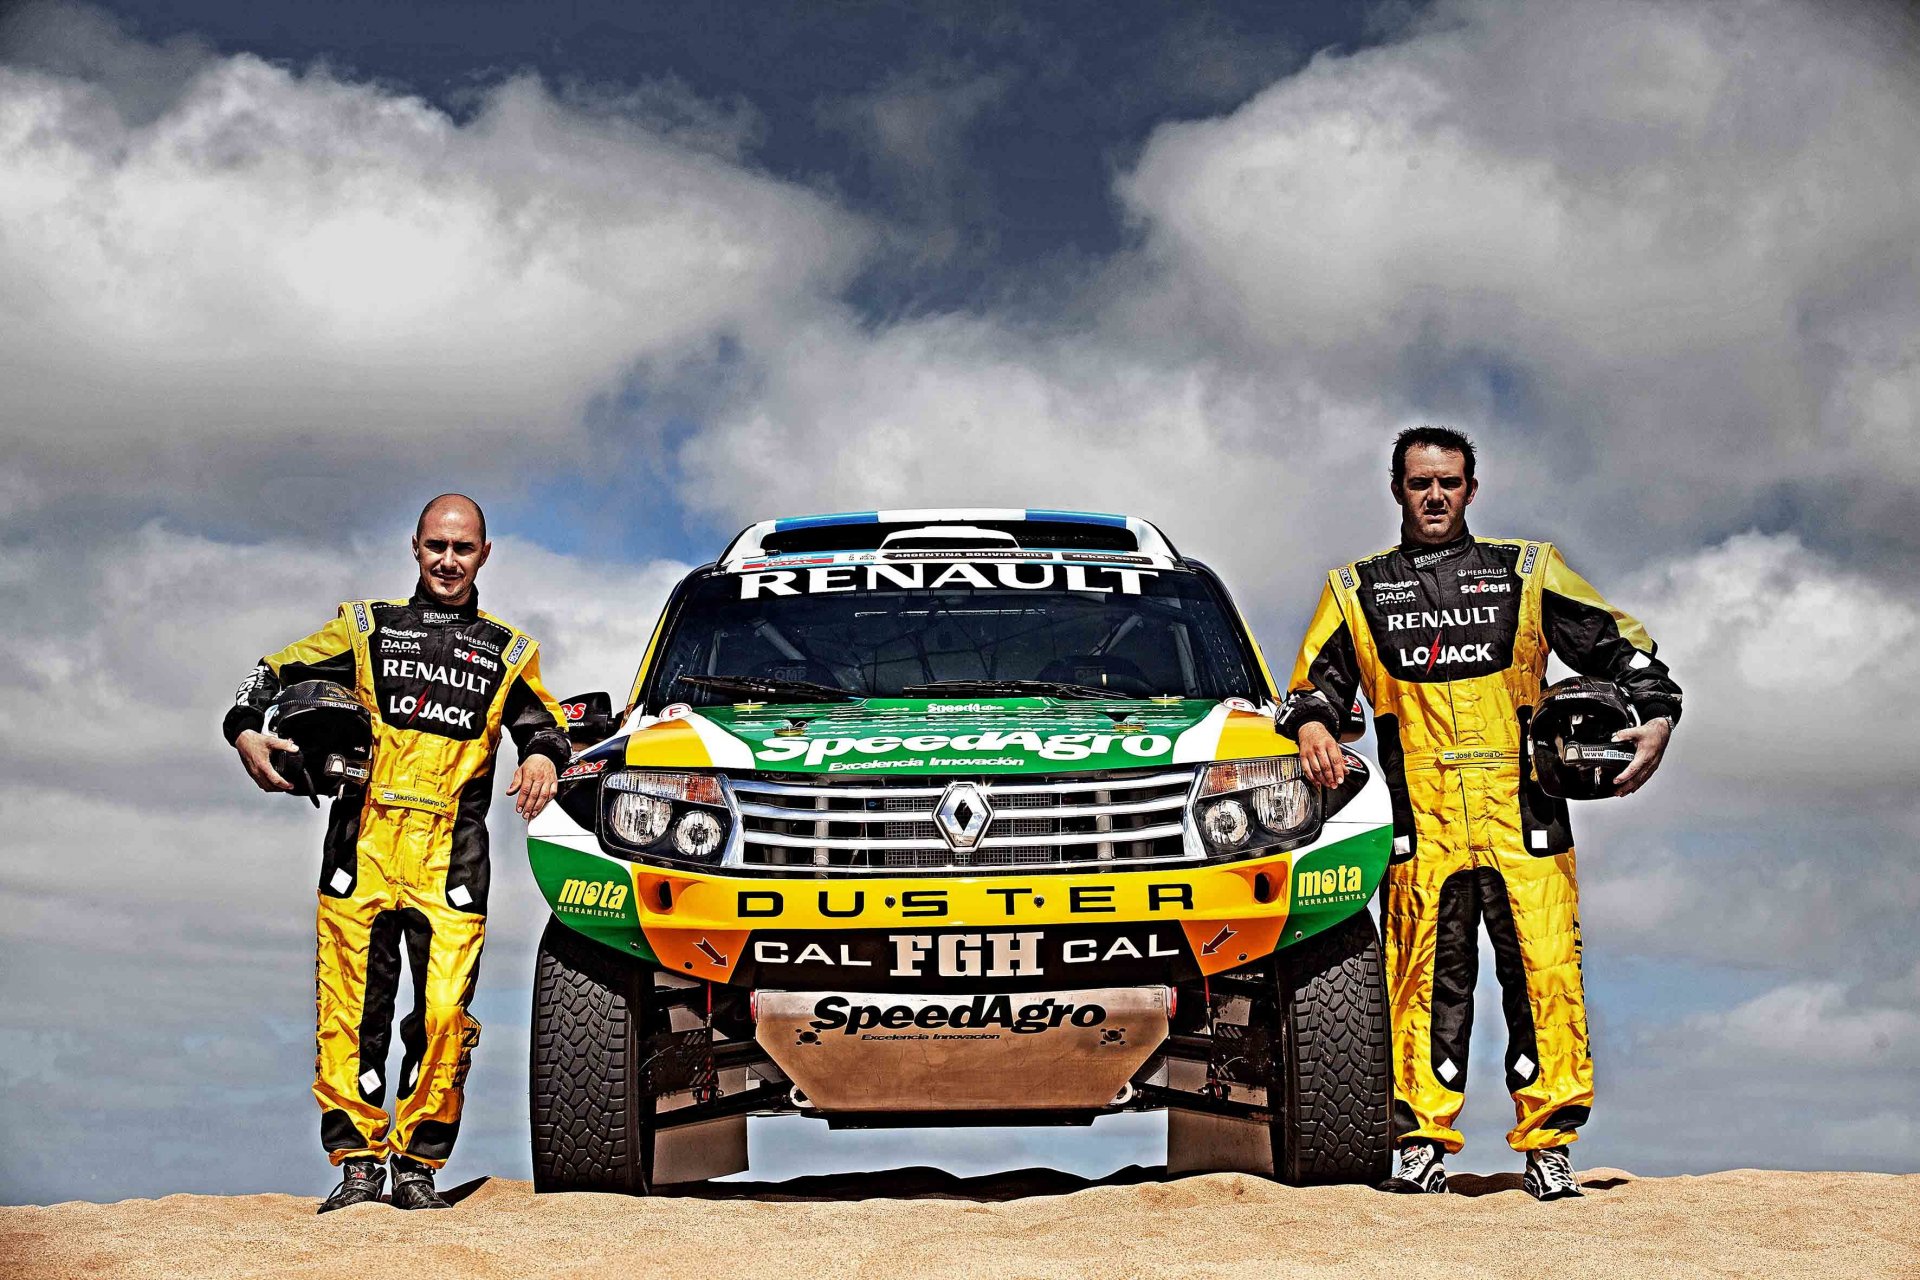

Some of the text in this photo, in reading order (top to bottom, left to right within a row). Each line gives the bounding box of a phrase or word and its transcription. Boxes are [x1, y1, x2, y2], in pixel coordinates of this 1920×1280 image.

[1414, 549, 1450, 564] RENAULT
[1467, 567, 1508, 576] HERBALIFE
[739, 563, 1159, 600] RENAULT
[1373, 580, 1420, 590] SpeedAgro
[1375, 590, 1417, 603] DADA
[423, 612, 460, 620] RENAULT
[1387, 606, 1499, 631] RENAULT
[380, 626, 428, 639] SpeedAgro
[381, 639, 421, 651] DADA
[463, 635, 500, 652] HERBALIFE
[383, 659, 491, 695] RENAULT
[330, 701, 358, 711] RENAULT
[668, 707, 682, 718] F
[755, 731, 1172, 766] SpeedAgro
[828, 757, 1024, 772] Excelencia Innovación
[1298, 865, 1361, 897] mota
[558, 879, 628, 910] mota
[738, 884, 1195, 917] DUSTER
[1298, 893, 1367, 907] HERRAMIENTAS
[557, 905, 626, 920] HERRAMIENTAS
[754, 931, 1179, 977] CAL FGH CAL
[809, 995, 1107, 1035] SpeedAgro
[861, 1033, 930, 1041] Excelencia
